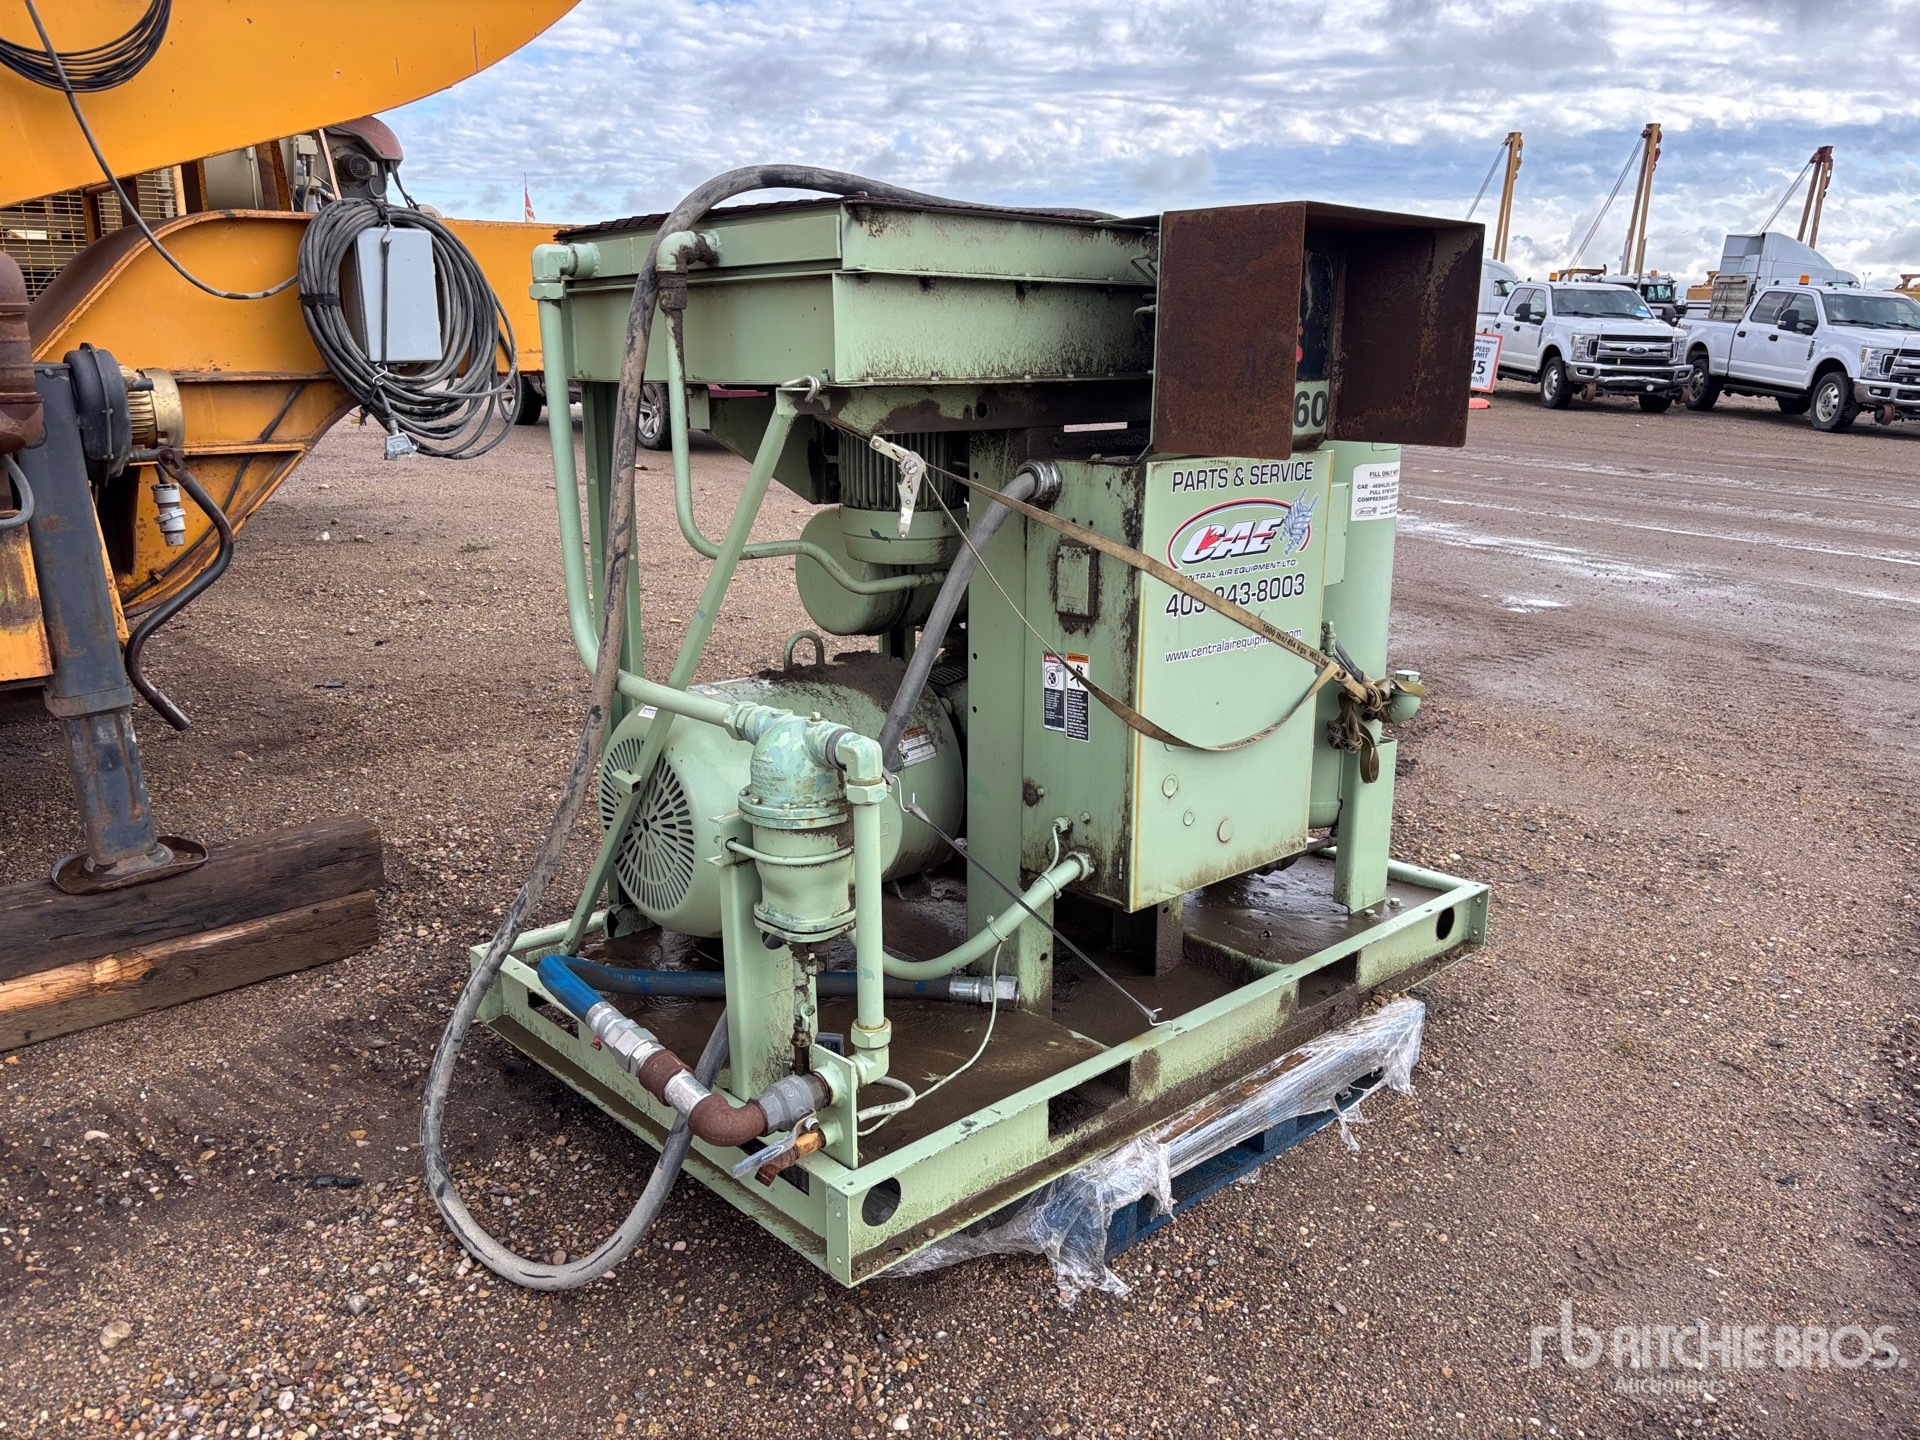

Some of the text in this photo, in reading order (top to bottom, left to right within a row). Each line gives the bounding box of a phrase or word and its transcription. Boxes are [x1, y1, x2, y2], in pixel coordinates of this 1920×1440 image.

[1472, 360, 1486, 375] 15
[1293, 391, 1328, 428] 60
[1171, 461, 1313, 493] PARTS & SERVICE
[1181, 517, 1285, 564] CAE
[1184, 559, 1298, 581] NTRAL AIR EQUIPMENT LTD.
[1166, 573, 1305, 618] 4043-8003
[1166, 628, 1302, 663] www.centralairequipmom
[1262, 623, 1276, 637] 1000
[1297, 642, 1307, 656] kgs
